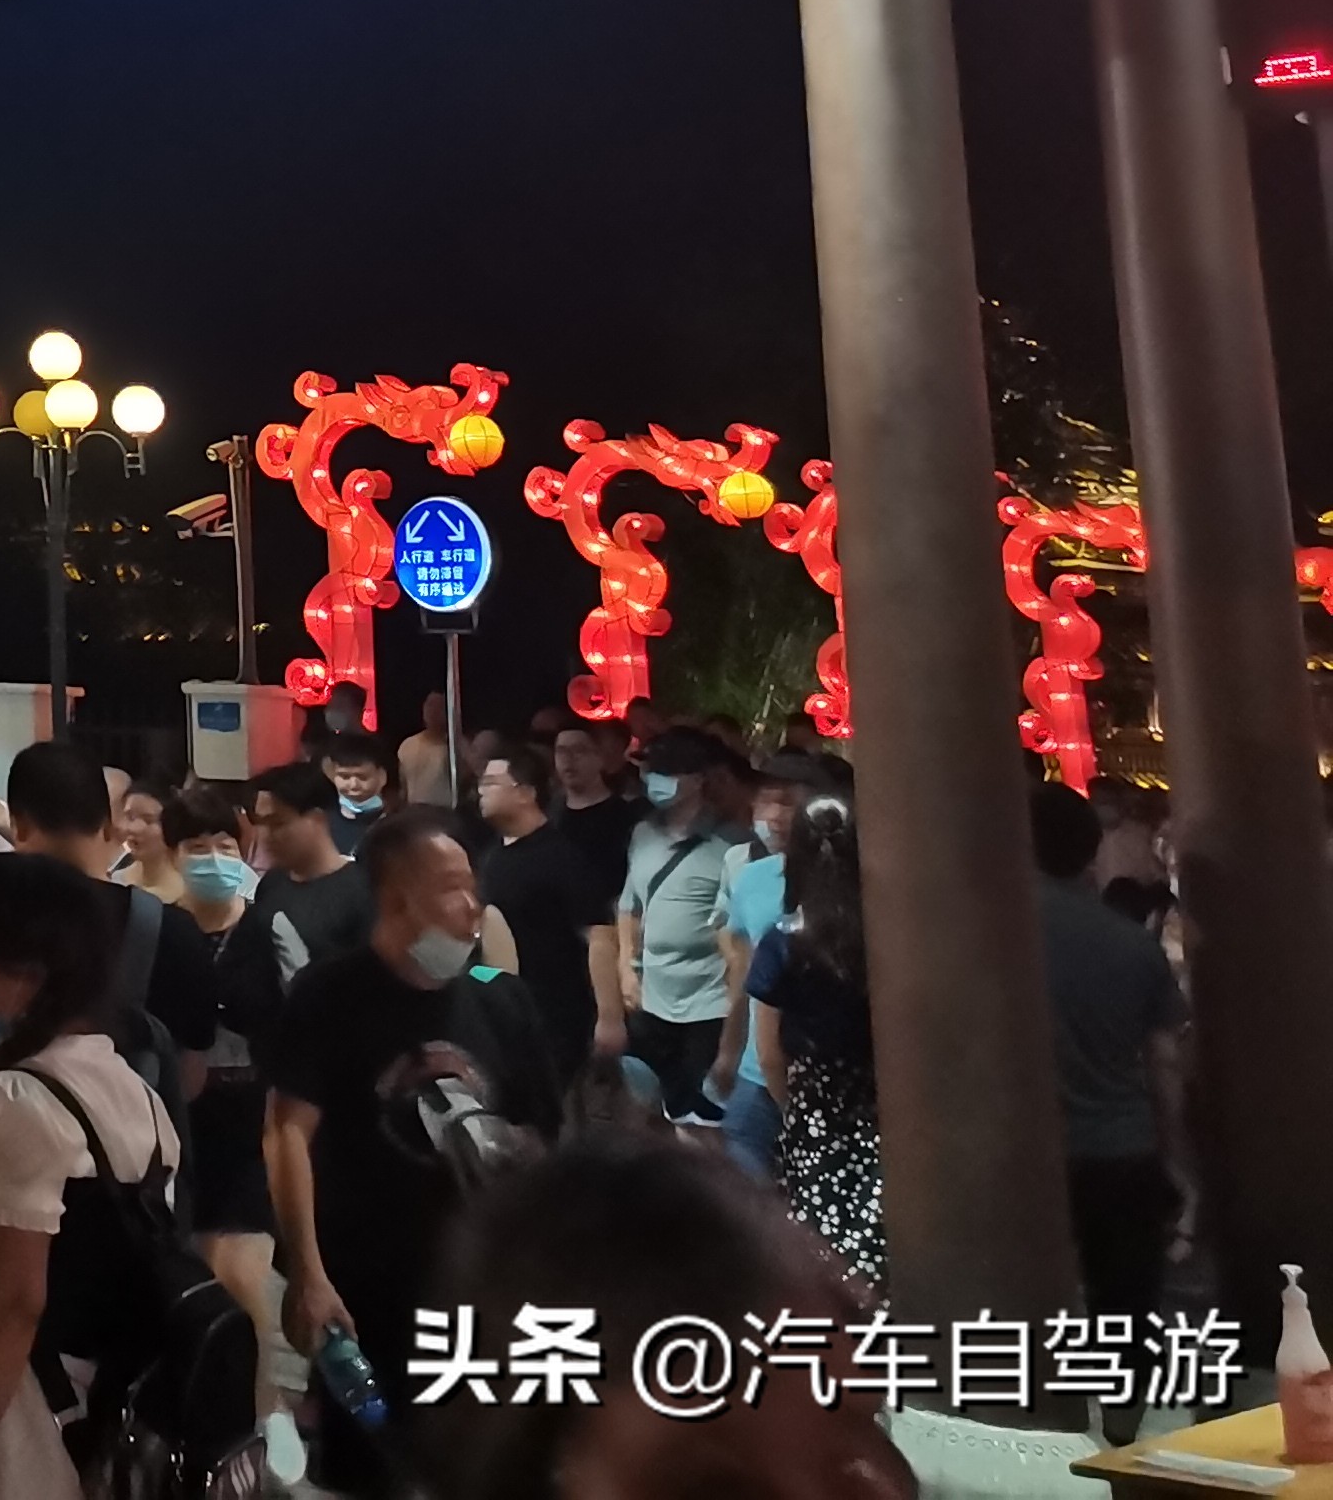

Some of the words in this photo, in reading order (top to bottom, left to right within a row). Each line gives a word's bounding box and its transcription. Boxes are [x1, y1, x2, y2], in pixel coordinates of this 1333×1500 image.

[399, 549, 435, 564] 人行道
[440, 548, 475, 562] 车行道
[416, 566, 464, 581] 请勿滞留
[416, 581, 466, 597] 有序通过
